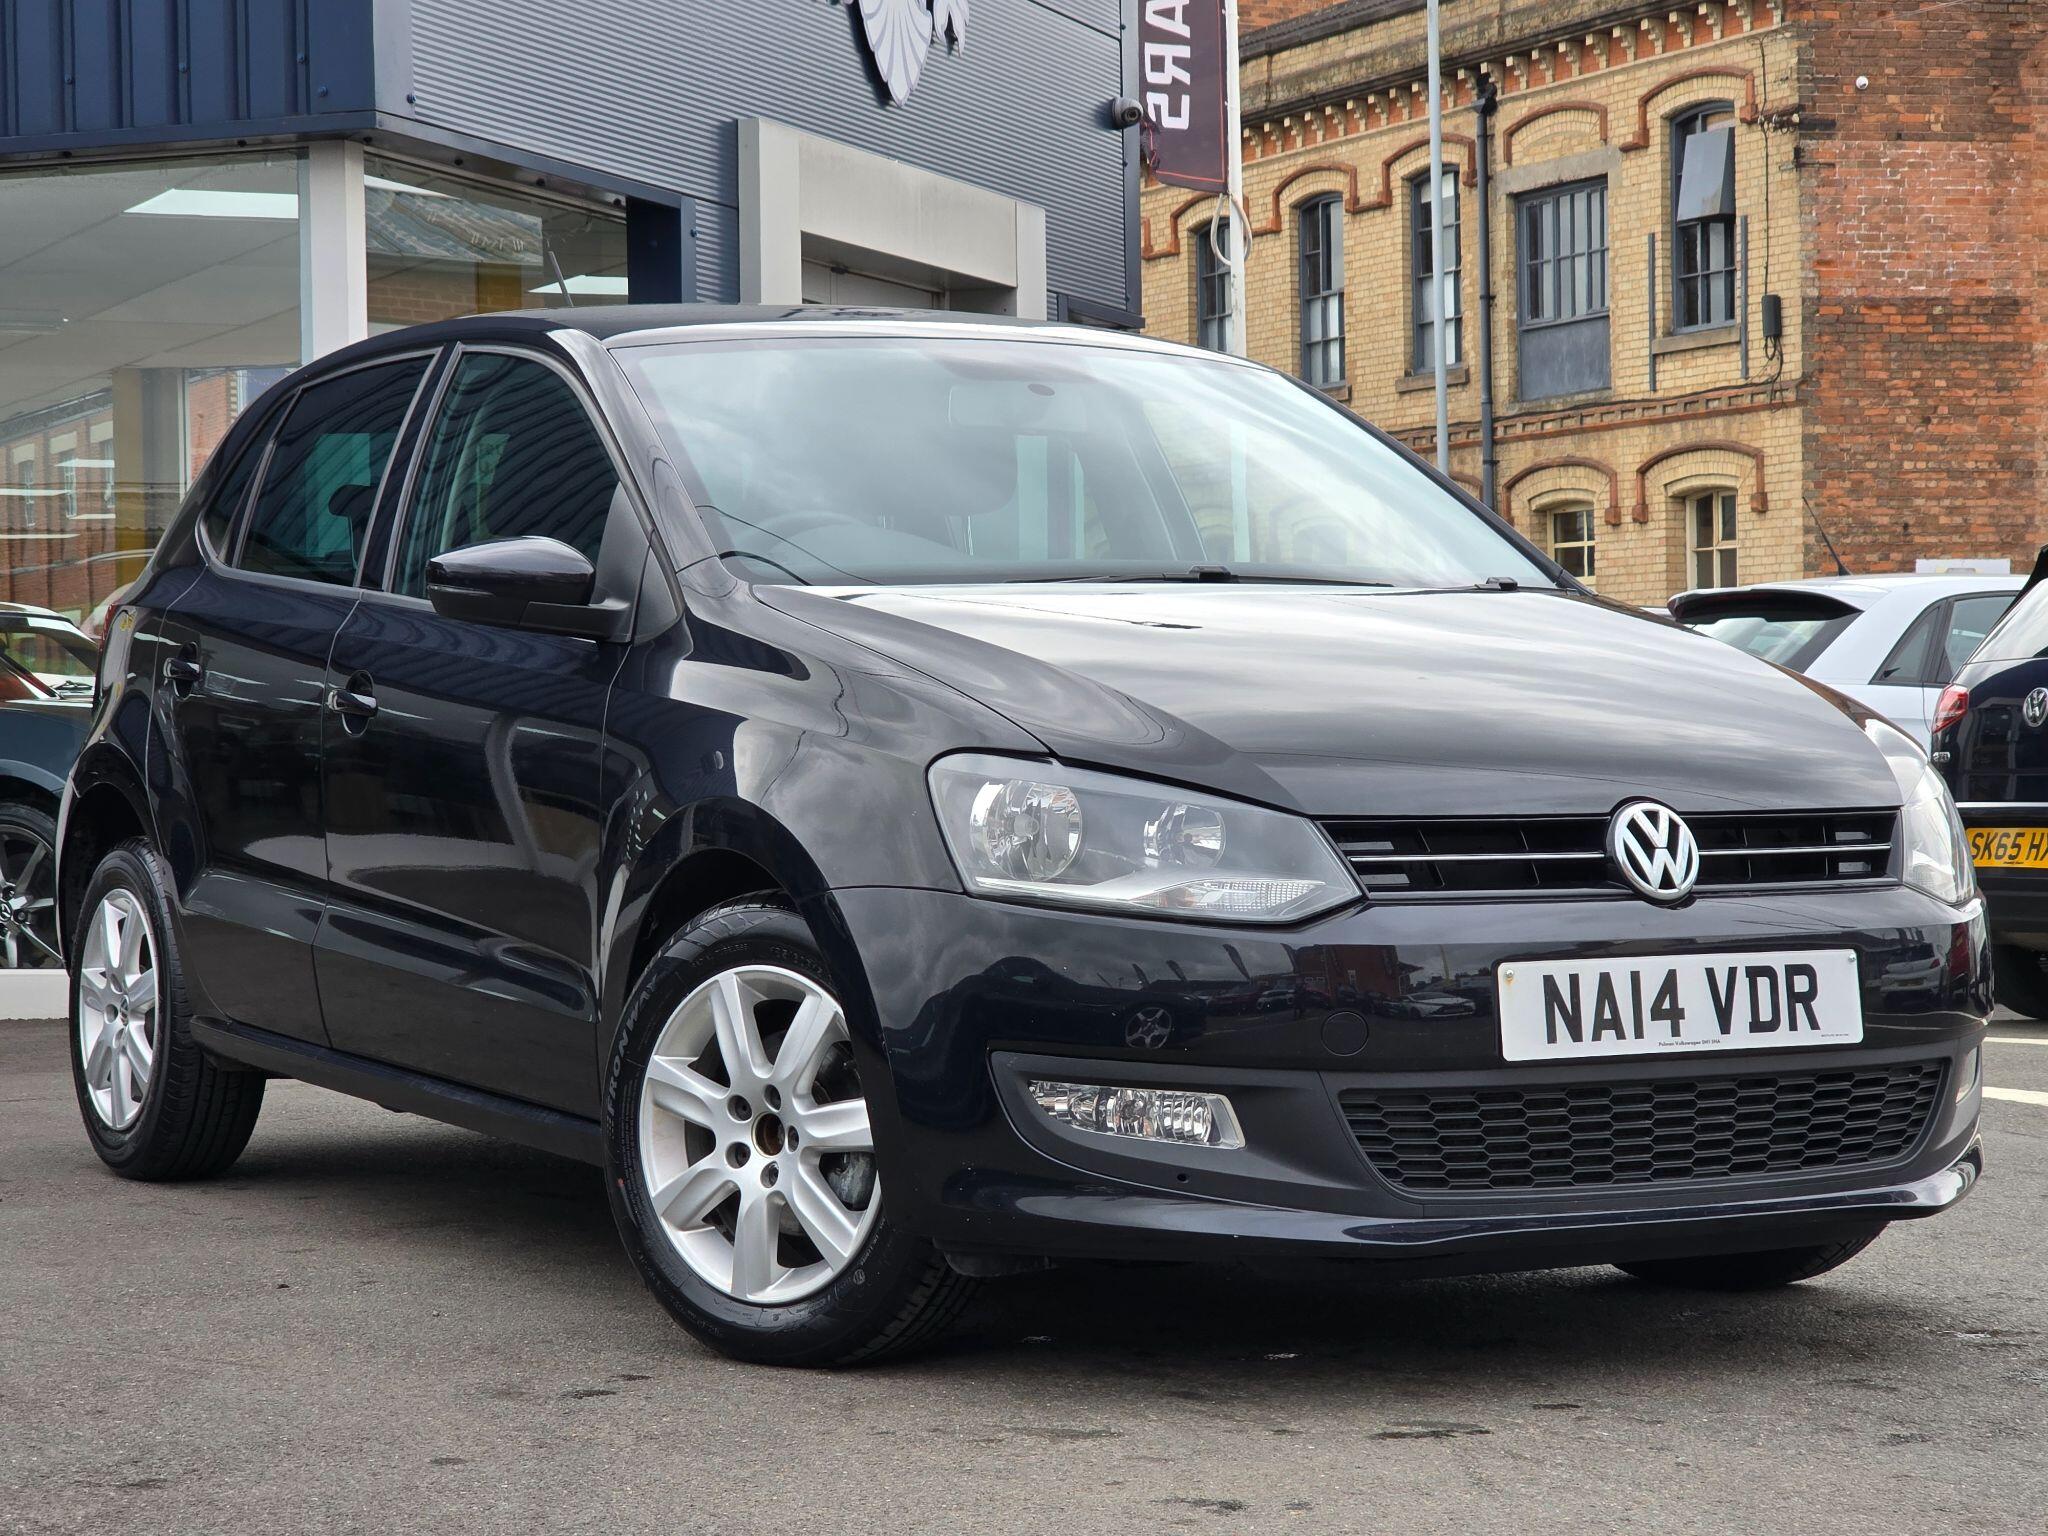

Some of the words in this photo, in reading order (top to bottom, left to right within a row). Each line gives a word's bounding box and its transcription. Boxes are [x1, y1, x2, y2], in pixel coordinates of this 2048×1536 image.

[1617, 803, 1698, 898] VW
[1971, 832, 2026, 861] SK65
[1542, 968, 1686, 1045] NA14
[1704, 963, 1821, 1036] VDR
